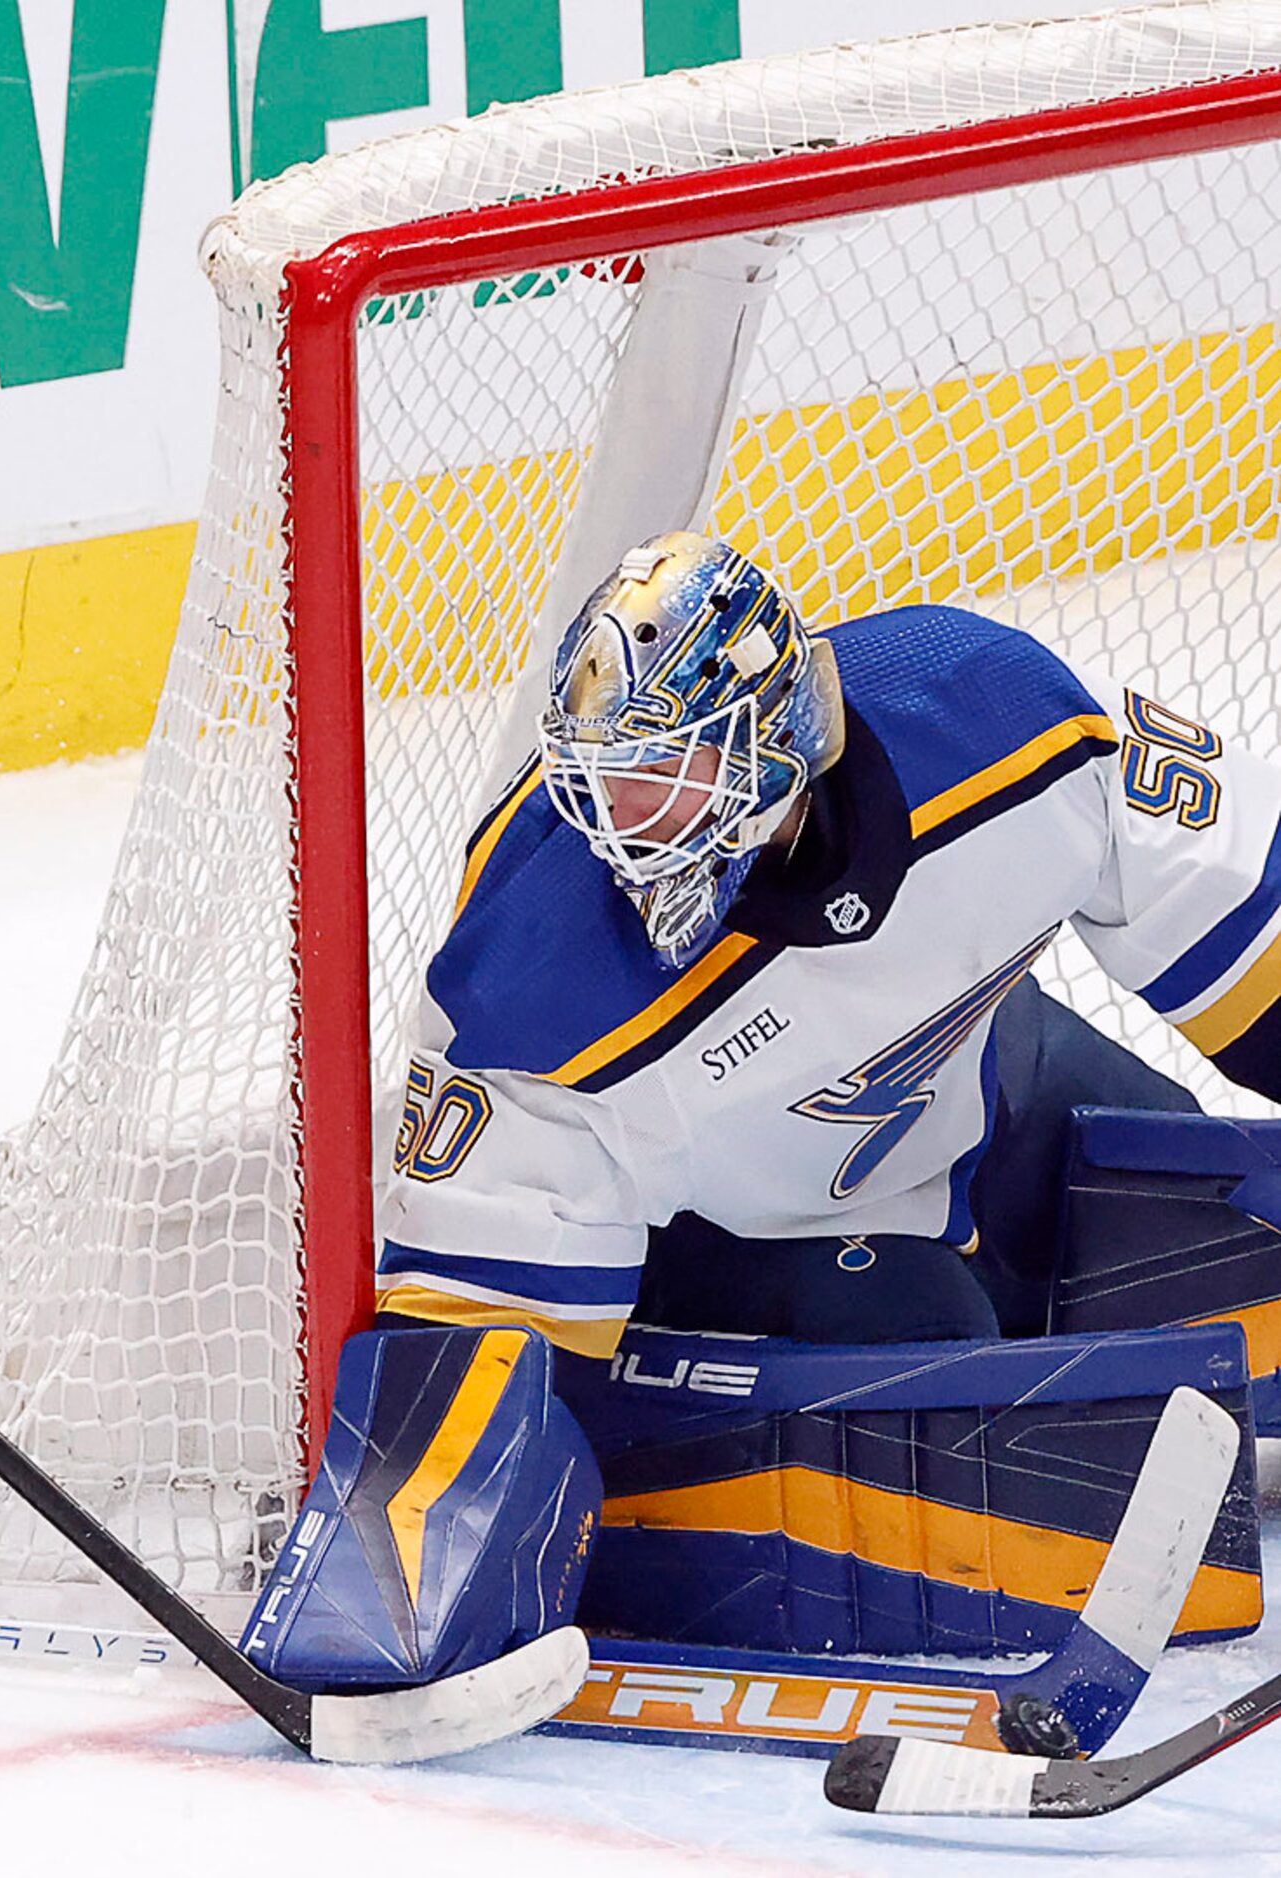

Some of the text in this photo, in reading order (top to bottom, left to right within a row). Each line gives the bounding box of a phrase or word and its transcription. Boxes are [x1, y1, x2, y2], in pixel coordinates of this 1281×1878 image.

[1120, 687, 1222, 831] 50
[701, 1007, 791, 1081] STIFEL
[242, 1509, 326, 1656] TRUE
